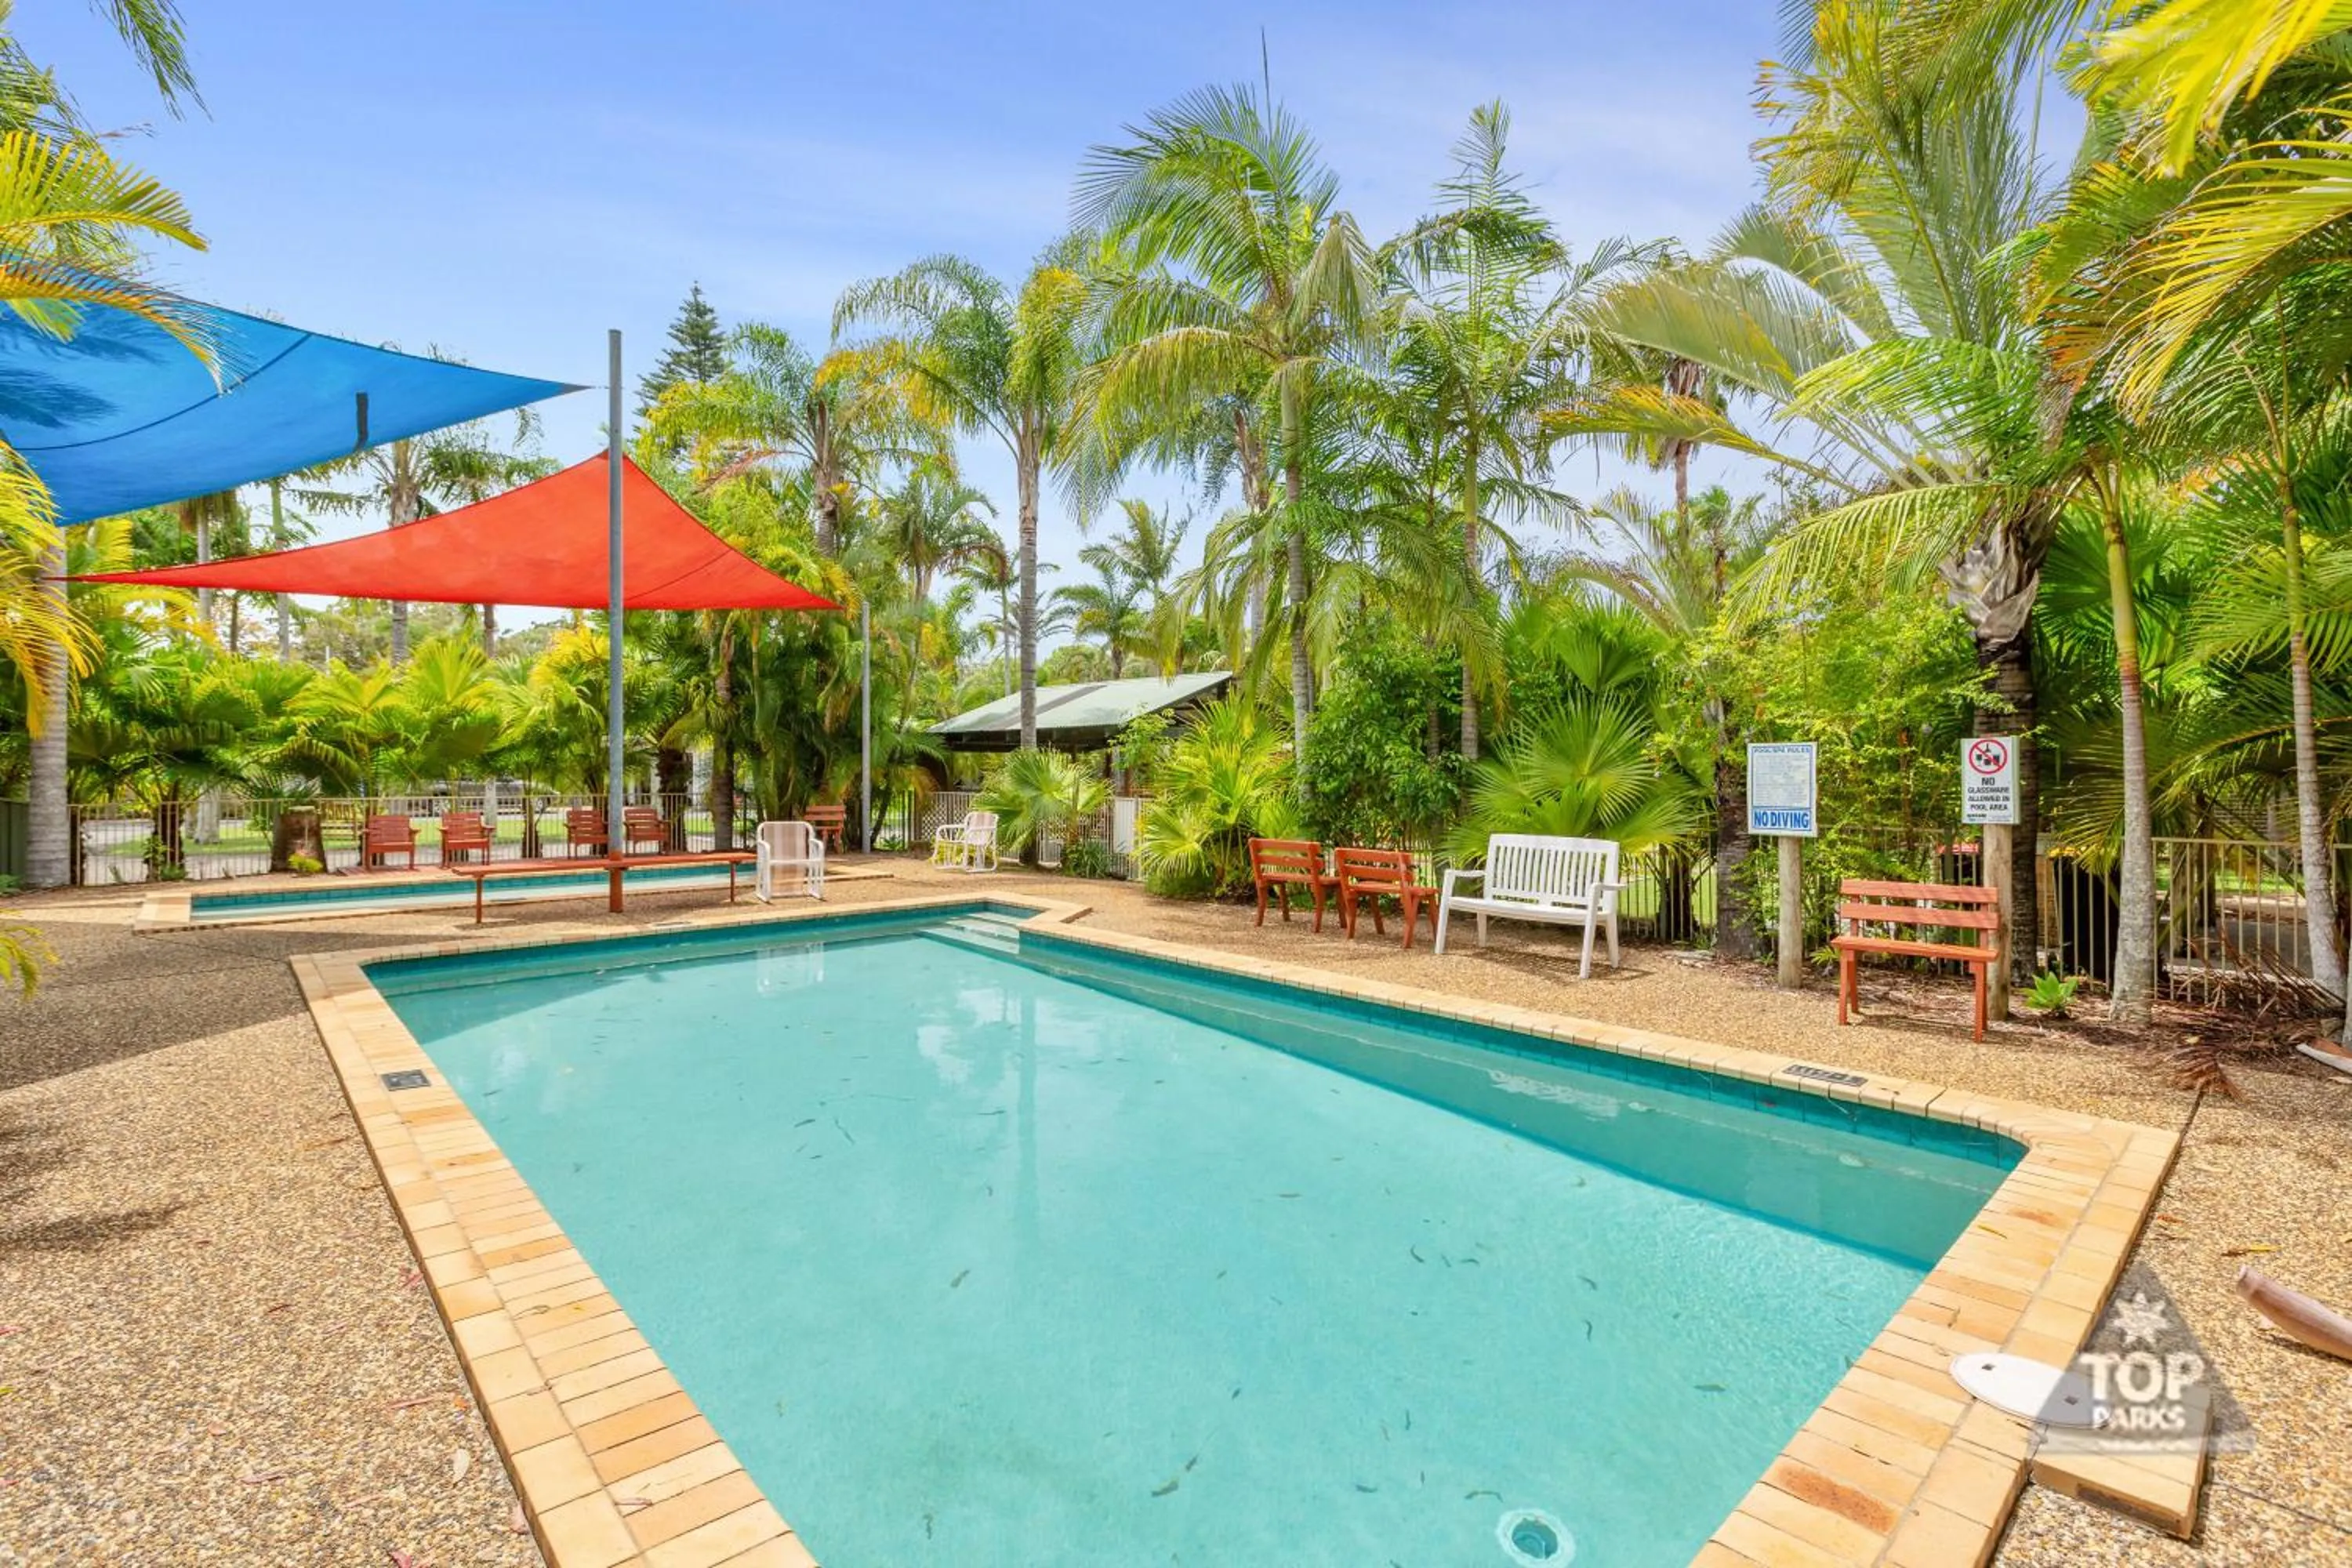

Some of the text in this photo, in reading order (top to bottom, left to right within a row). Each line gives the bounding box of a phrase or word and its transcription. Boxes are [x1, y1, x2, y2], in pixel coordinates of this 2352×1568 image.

[1981, 777, 1995, 786] NO
[1754, 811, 1809, 829] NO DIVING
